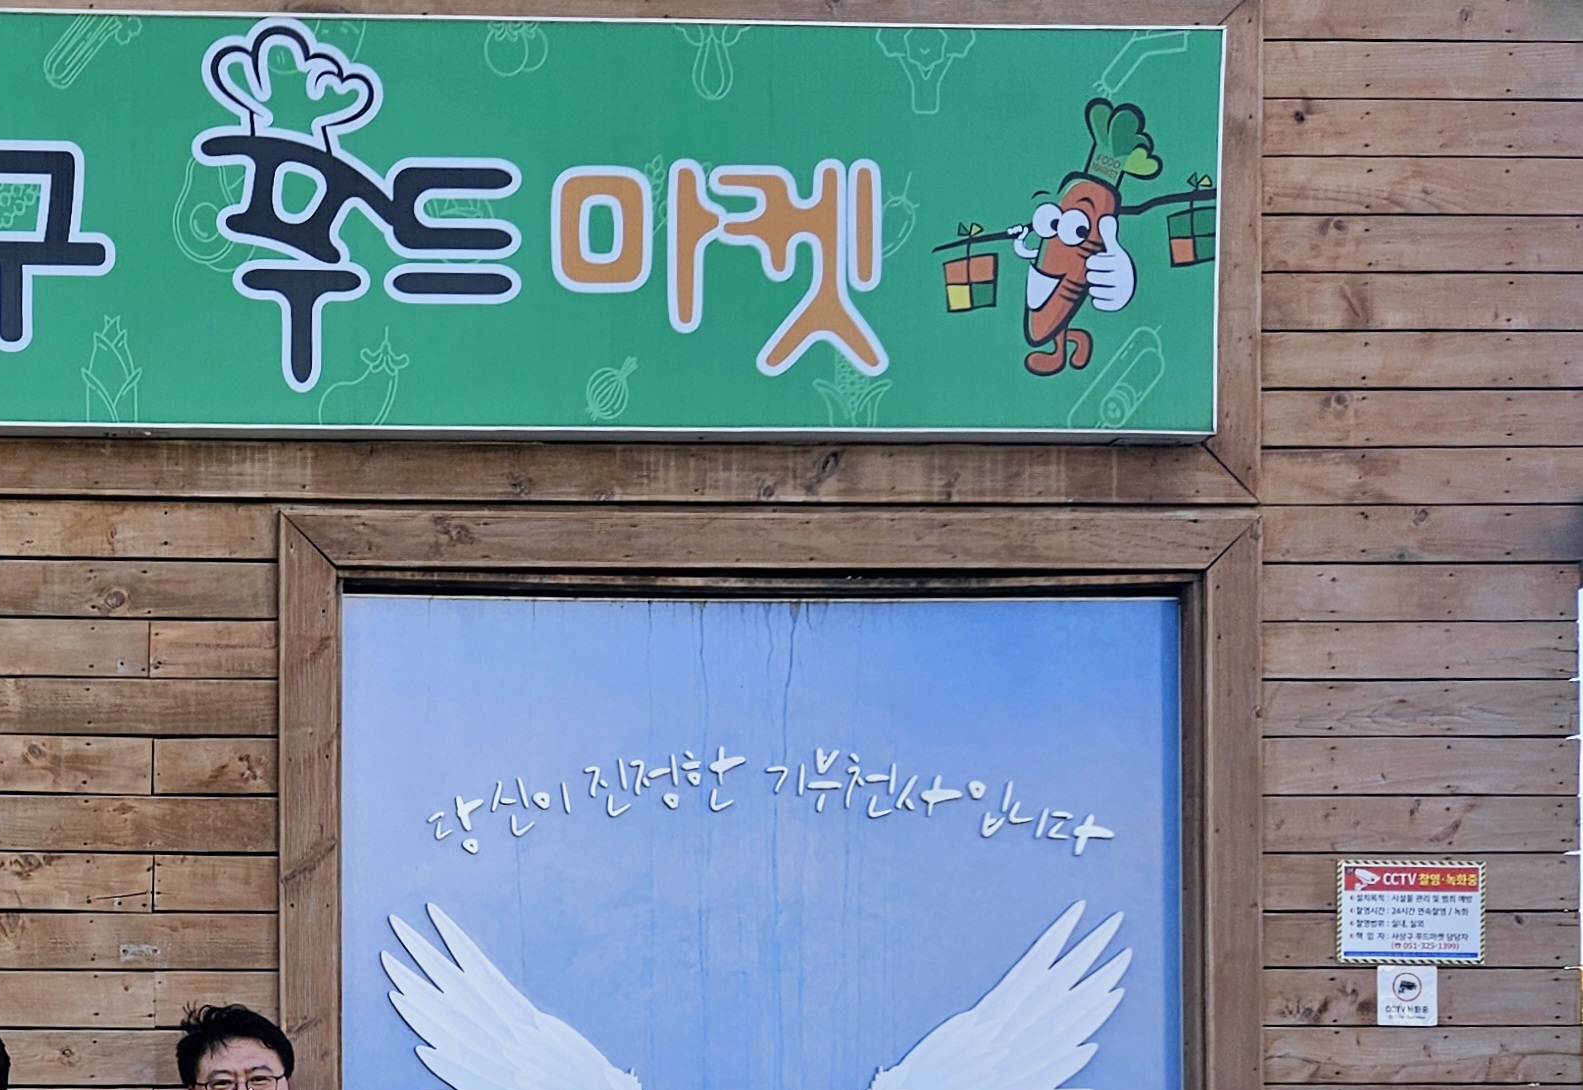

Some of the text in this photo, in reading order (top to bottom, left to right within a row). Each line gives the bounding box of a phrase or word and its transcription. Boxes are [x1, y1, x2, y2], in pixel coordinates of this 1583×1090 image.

[426, 777, 571, 856] 당신이
[583, 746, 747, 820] 진정한
[1382, 873, 1416, 885] CCTV
[1392, 907, 1415, 915] 24시간
[1392, 933, 1413, 941] 사상구
